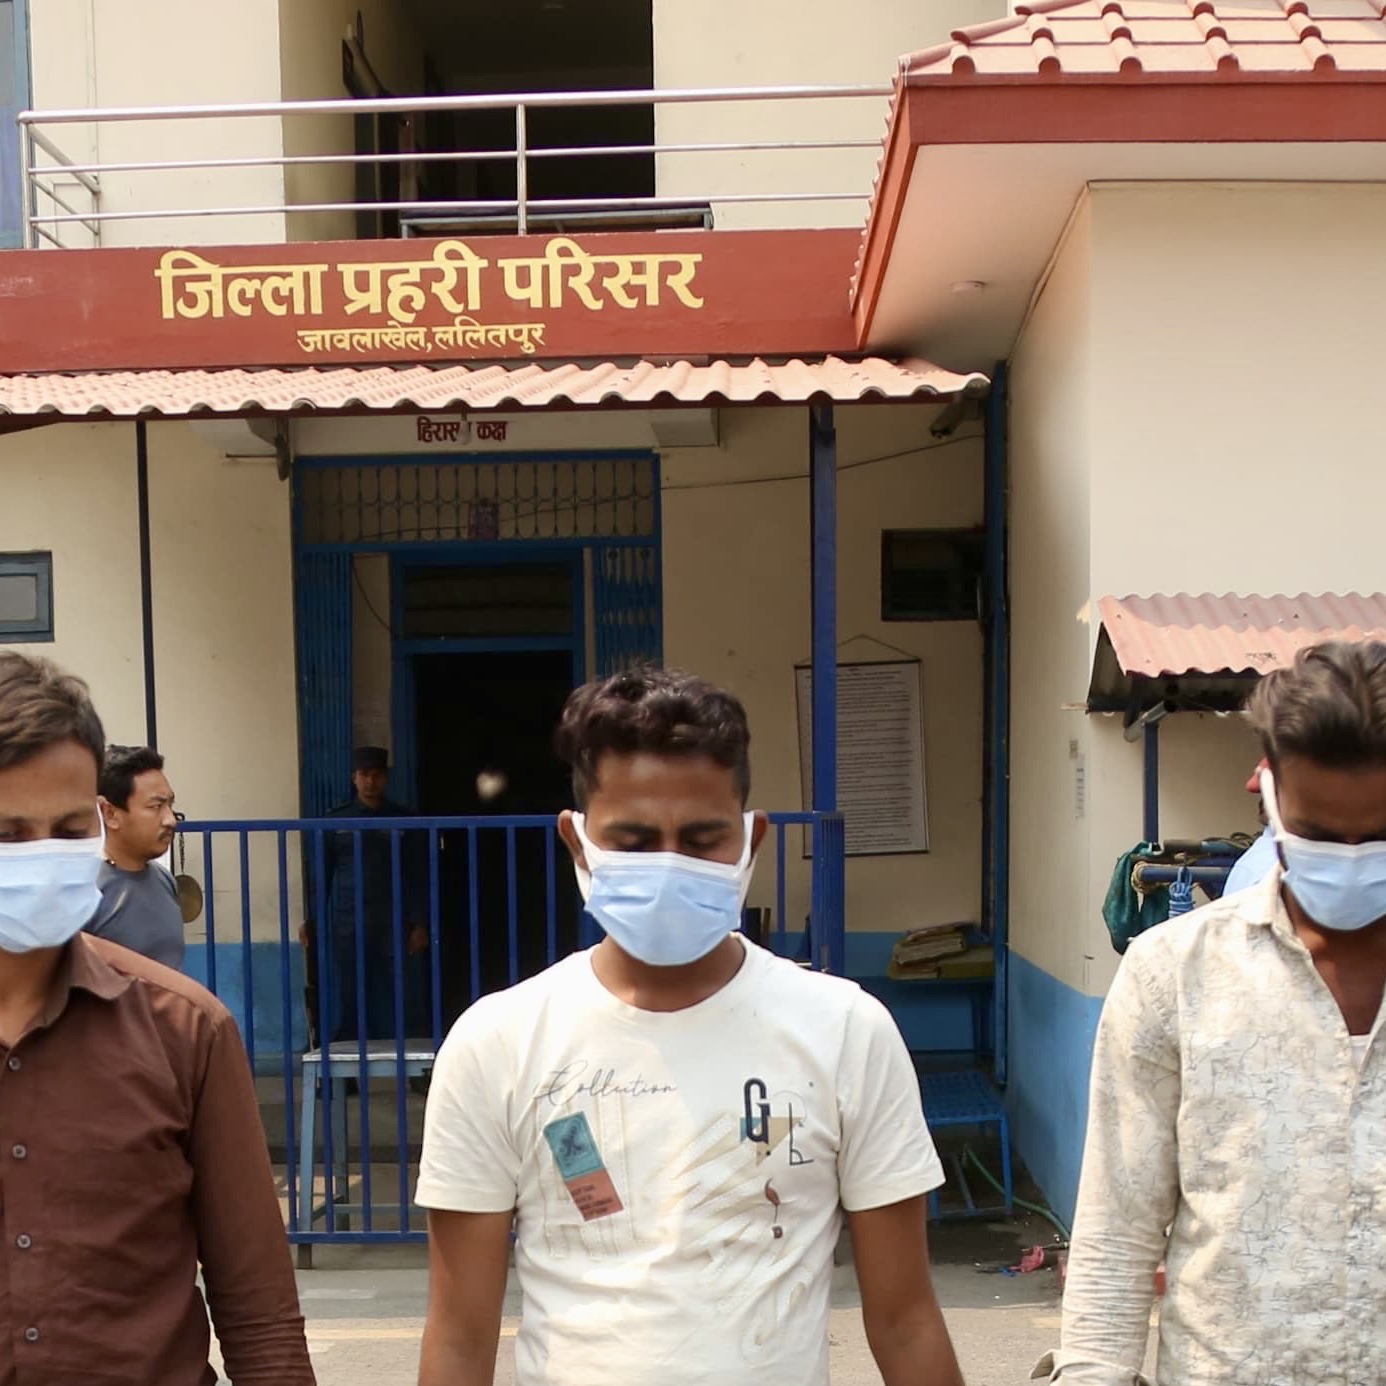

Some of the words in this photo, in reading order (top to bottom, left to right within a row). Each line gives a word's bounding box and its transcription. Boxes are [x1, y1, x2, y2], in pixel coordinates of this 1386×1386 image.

[155, 250, 328, 320] जिल्ला
[337, 240, 488, 323] प्रहरी
[498, 236, 704, 312] परिसर
[744, 1077, 771, 1145] G
